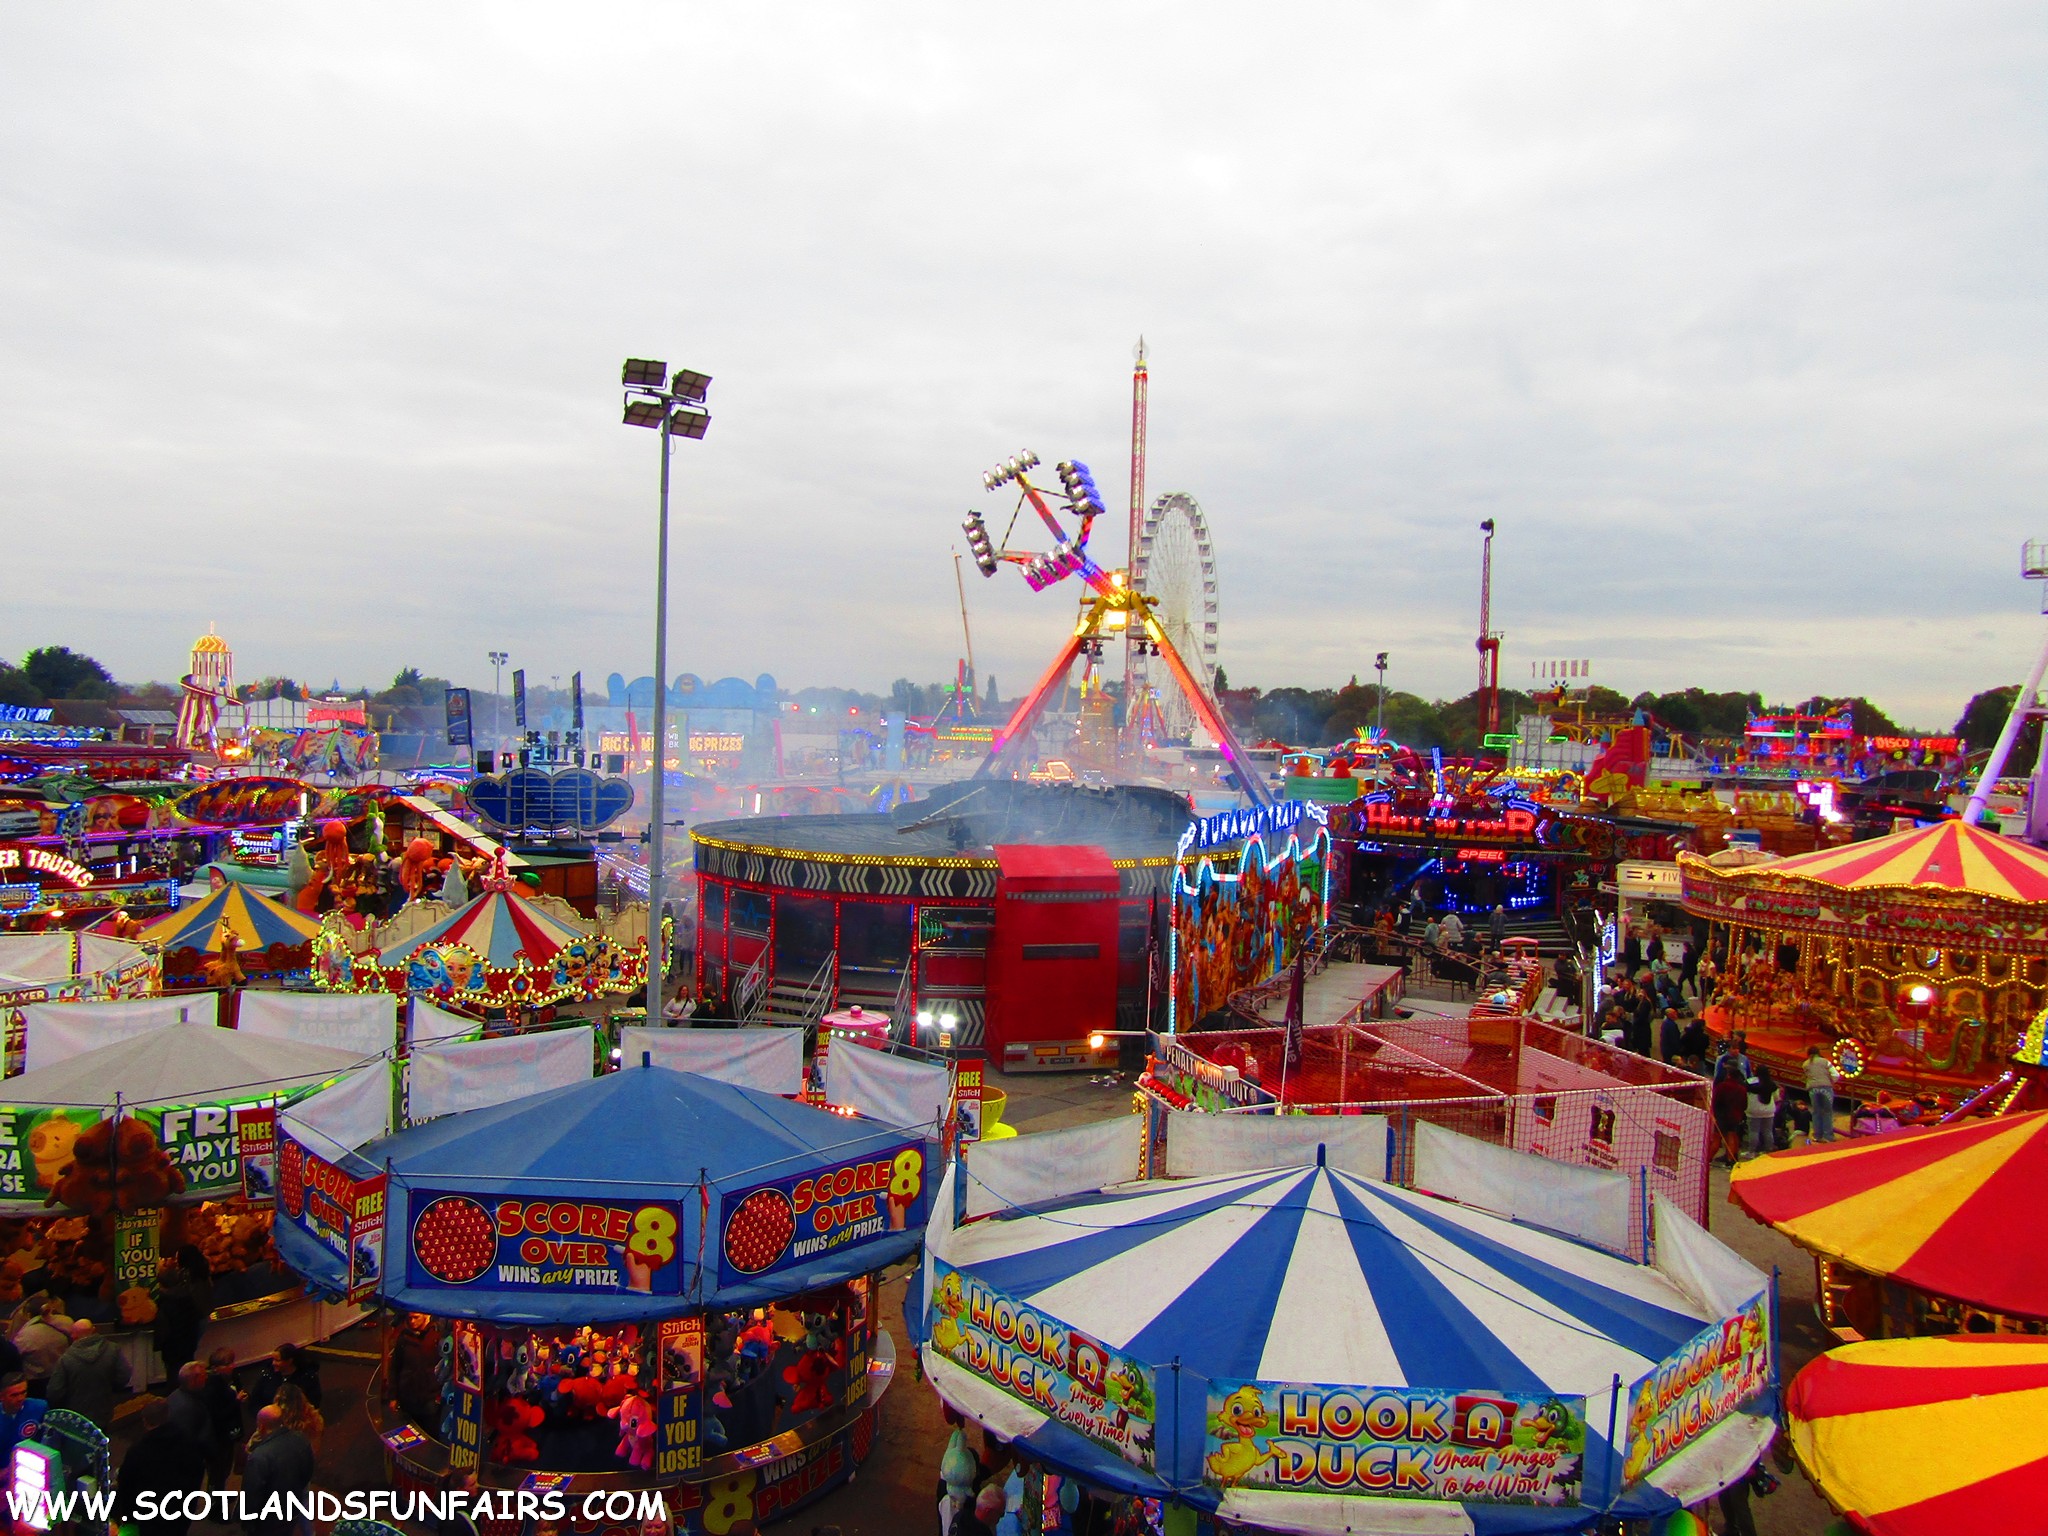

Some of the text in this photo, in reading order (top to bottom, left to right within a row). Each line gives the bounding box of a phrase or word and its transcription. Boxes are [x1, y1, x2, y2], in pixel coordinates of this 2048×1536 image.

[602, 736, 621, 752] BIG
[704, 735, 743, 752] PRIZES
[1875, 737, 1910, 749] DISCO
[1199, 800, 1300, 848] RUNAWAY TRAIN
[235, 838, 273, 847] Donuts
[1357, 841, 1383, 852] ALL
[29, 850, 94, 887] TRUCKS
[1662, 871, 1681, 882] FIV
[0, 890, 36, 901] ONSTER
[0, 989, 46, 1004] LAYER
[1166, 1046, 1199, 1075] PENALTY
[958, 1071, 981, 1087] FREE
[240, 1121, 273, 1141] FREE
[188, 1159, 237, 1183] YOU
[304, 1155, 354, 1214] SCORE
[793, 1148, 923, 1214] SCORE 8
[310, 1192, 344, 1233] OVER
[355, 1190, 384, 1219] FREE
[813, 1195, 877, 1232] OVER
[131, 1233, 144, 1247] IF
[496, 1201, 633, 1242] SCORE
[628, 1204, 677, 1265] 8
[793, 1216, 884, 1258] WINS any PRIZE
[121, 1248, 154, 1263] YOU
[520, 1237, 609, 1266] OVER
[118, 1264, 156, 1281] LOSE
[498, 1264, 618, 1286] WINS any PRIZE
[662, 1319, 701, 1335] STITCH
[970, 1284, 1101, 1388] HOOK A
[853, 1331, 861, 1353] IF
[849, 1351, 865, 1379] YOU
[966, 1326, 1060, 1413] DUCK
[1656, 1321, 1740, 1414] HOOK A
[463, 1392, 473, 1415] IF
[673, 1394, 688, 1418] IF
[847, 1376, 867, 1407] LOSE!
[1068, 1382, 1104, 1413] Prize
[1058, 1404, 1132, 1449] Every Time!
[1279, 1389, 1503, 1443] HOOK A
[1651, 1380, 1715, 1464] DUCK
[457, 1417, 478, 1446] YOU
[665, 1419, 697, 1446] YOU
[659, 1446, 701, 1474] LOSE!
[762, 1453, 807, 1485] WINS
[1271, 1438, 1435, 1492] DUCK
[1433, 1447, 1560, 1476] Great Prizes
[756, 1441, 844, 1521] PRIZE
[1443, 1474, 1552, 1500] to be Won!
[702, 1470, 758, 1536] 8
